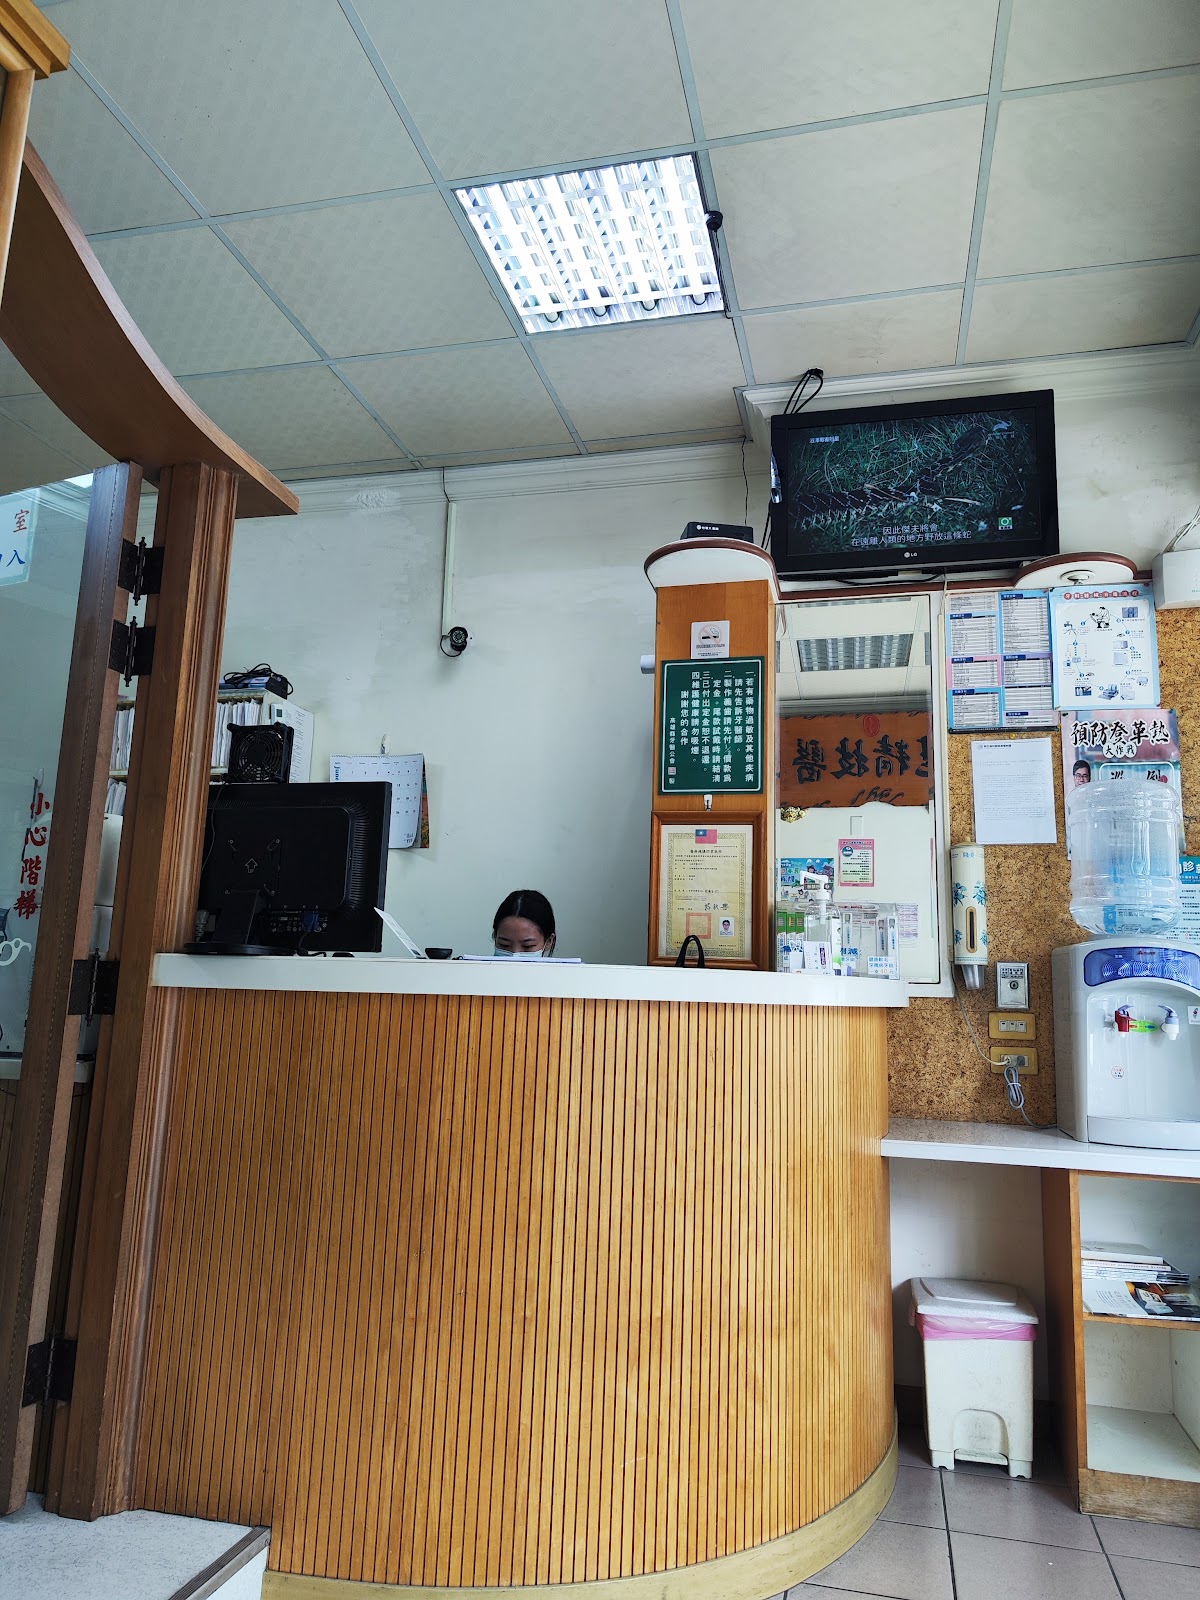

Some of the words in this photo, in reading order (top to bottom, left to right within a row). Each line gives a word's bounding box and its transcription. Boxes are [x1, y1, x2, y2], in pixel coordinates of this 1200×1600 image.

[13, 509, 30, 533] 室
[680, 690, 689, 746] 謝謝您的合作
[1070, 719, 1169, 746] 預防登革熱
[14, 791, 51, 921] 小心階梯
